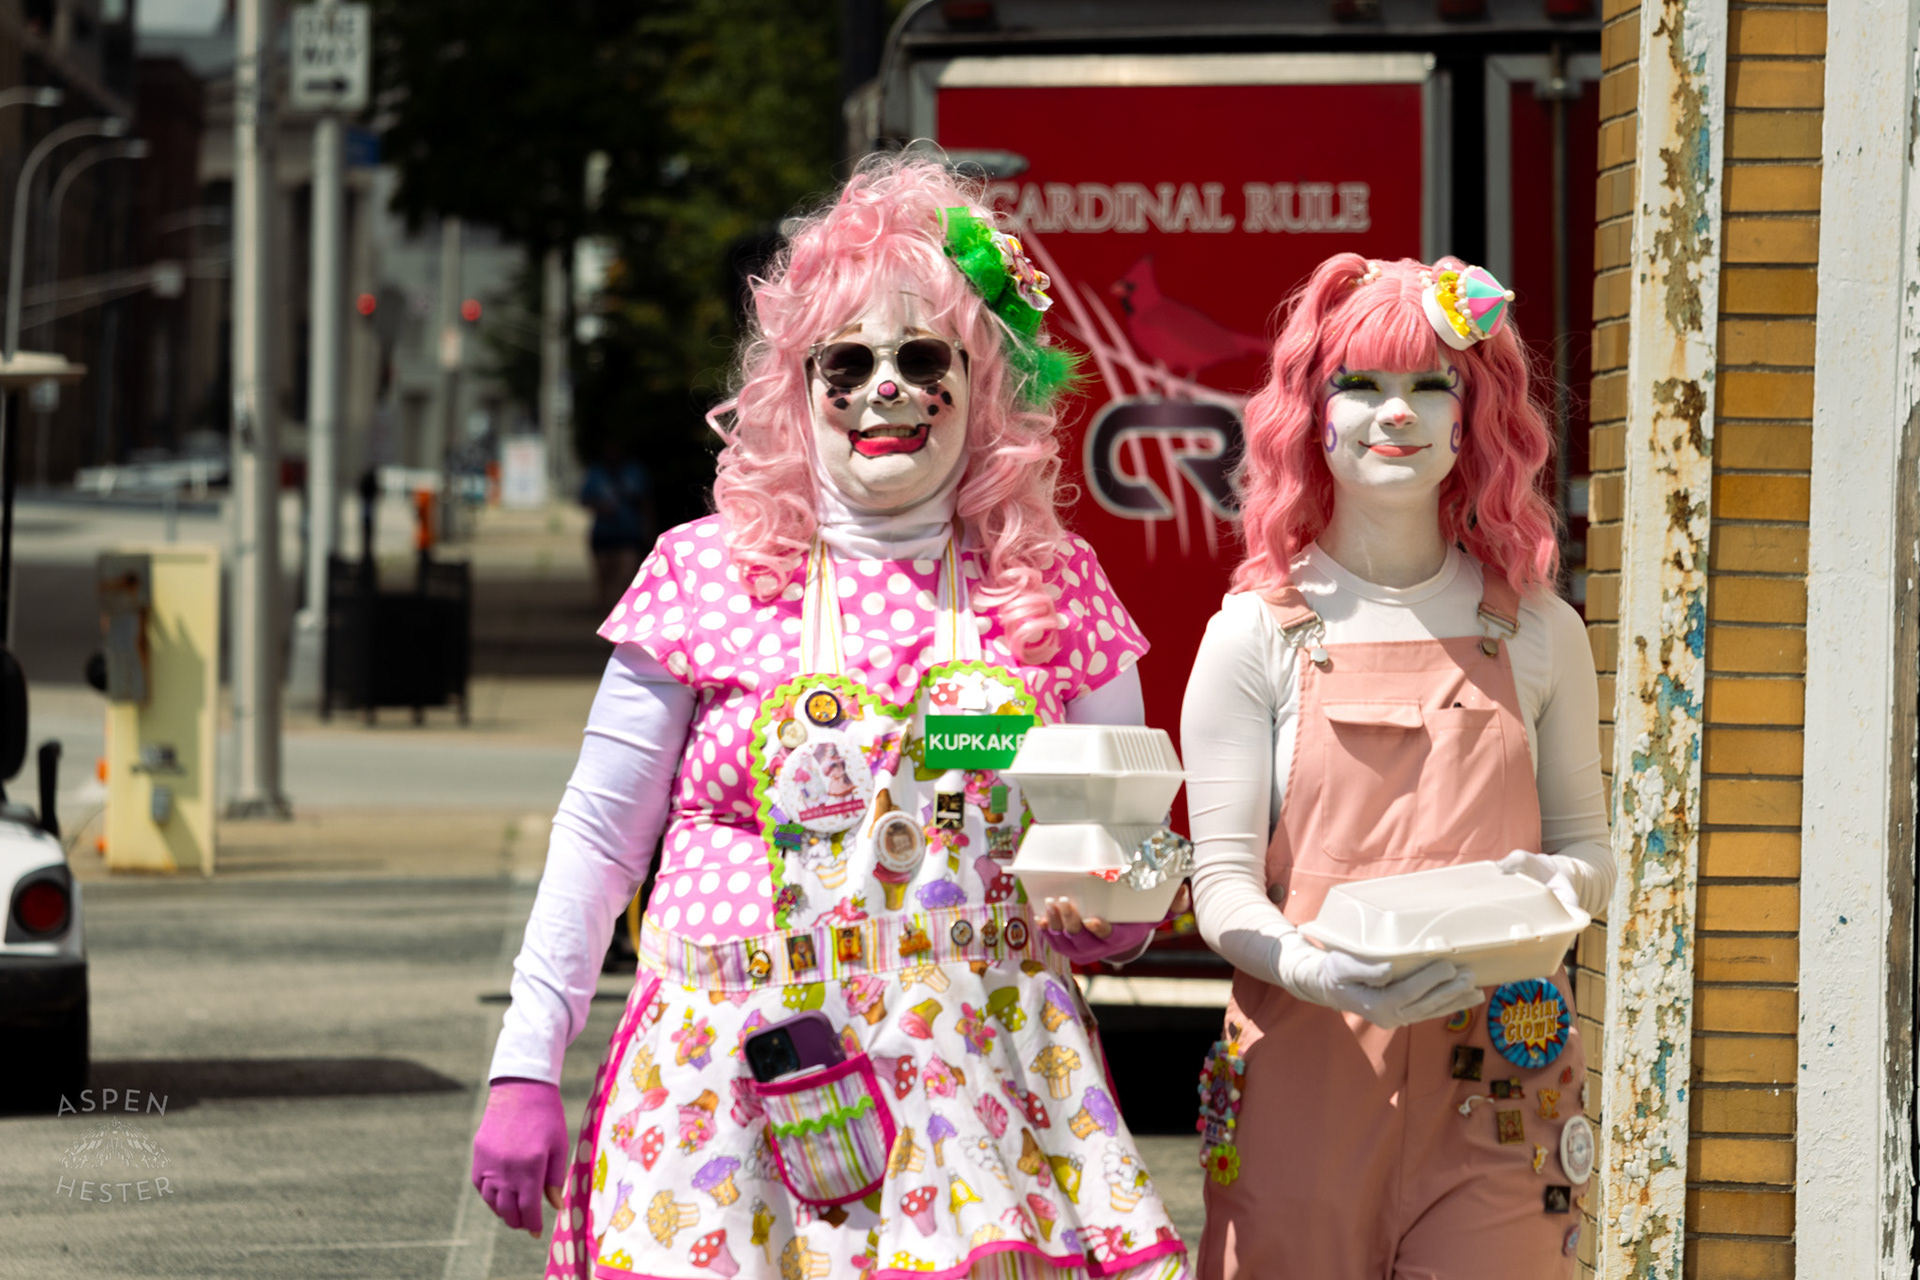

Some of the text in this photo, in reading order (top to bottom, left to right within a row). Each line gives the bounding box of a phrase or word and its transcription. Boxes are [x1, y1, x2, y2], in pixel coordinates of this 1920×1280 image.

[300, 16, 356, 37] ONE
[301, 44, 358, 67] WAY
[987, 181, 1371, 234] CARDINAL RULE
[1501, 999, 1560, 1026] OFFICIAL
[1504, 1016, 1557, 1045] CLOWN
